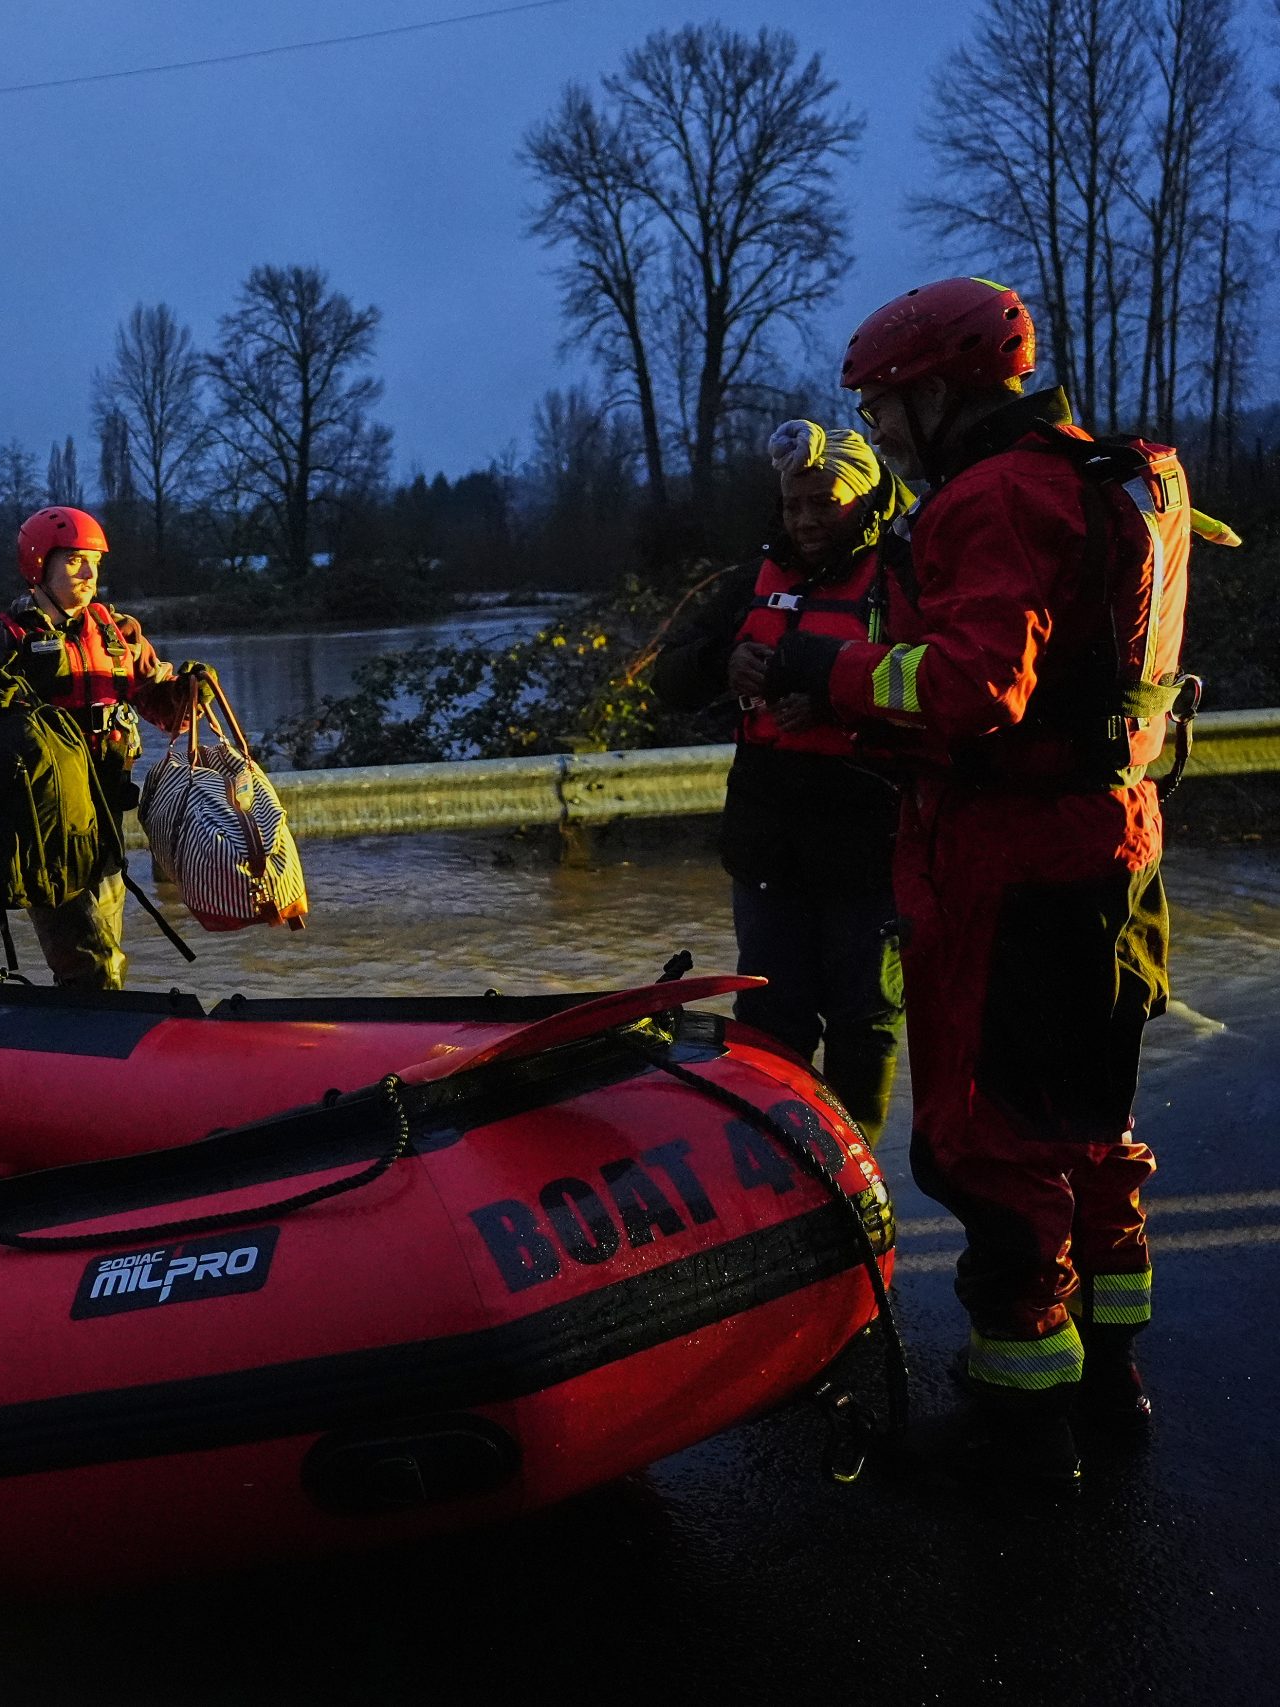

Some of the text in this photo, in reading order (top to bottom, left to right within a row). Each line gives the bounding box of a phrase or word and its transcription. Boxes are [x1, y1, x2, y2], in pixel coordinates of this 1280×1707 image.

[469, 1100, 846, 1294] BOAT 48
[98, 1250, 166, 1272] ZODIAC
